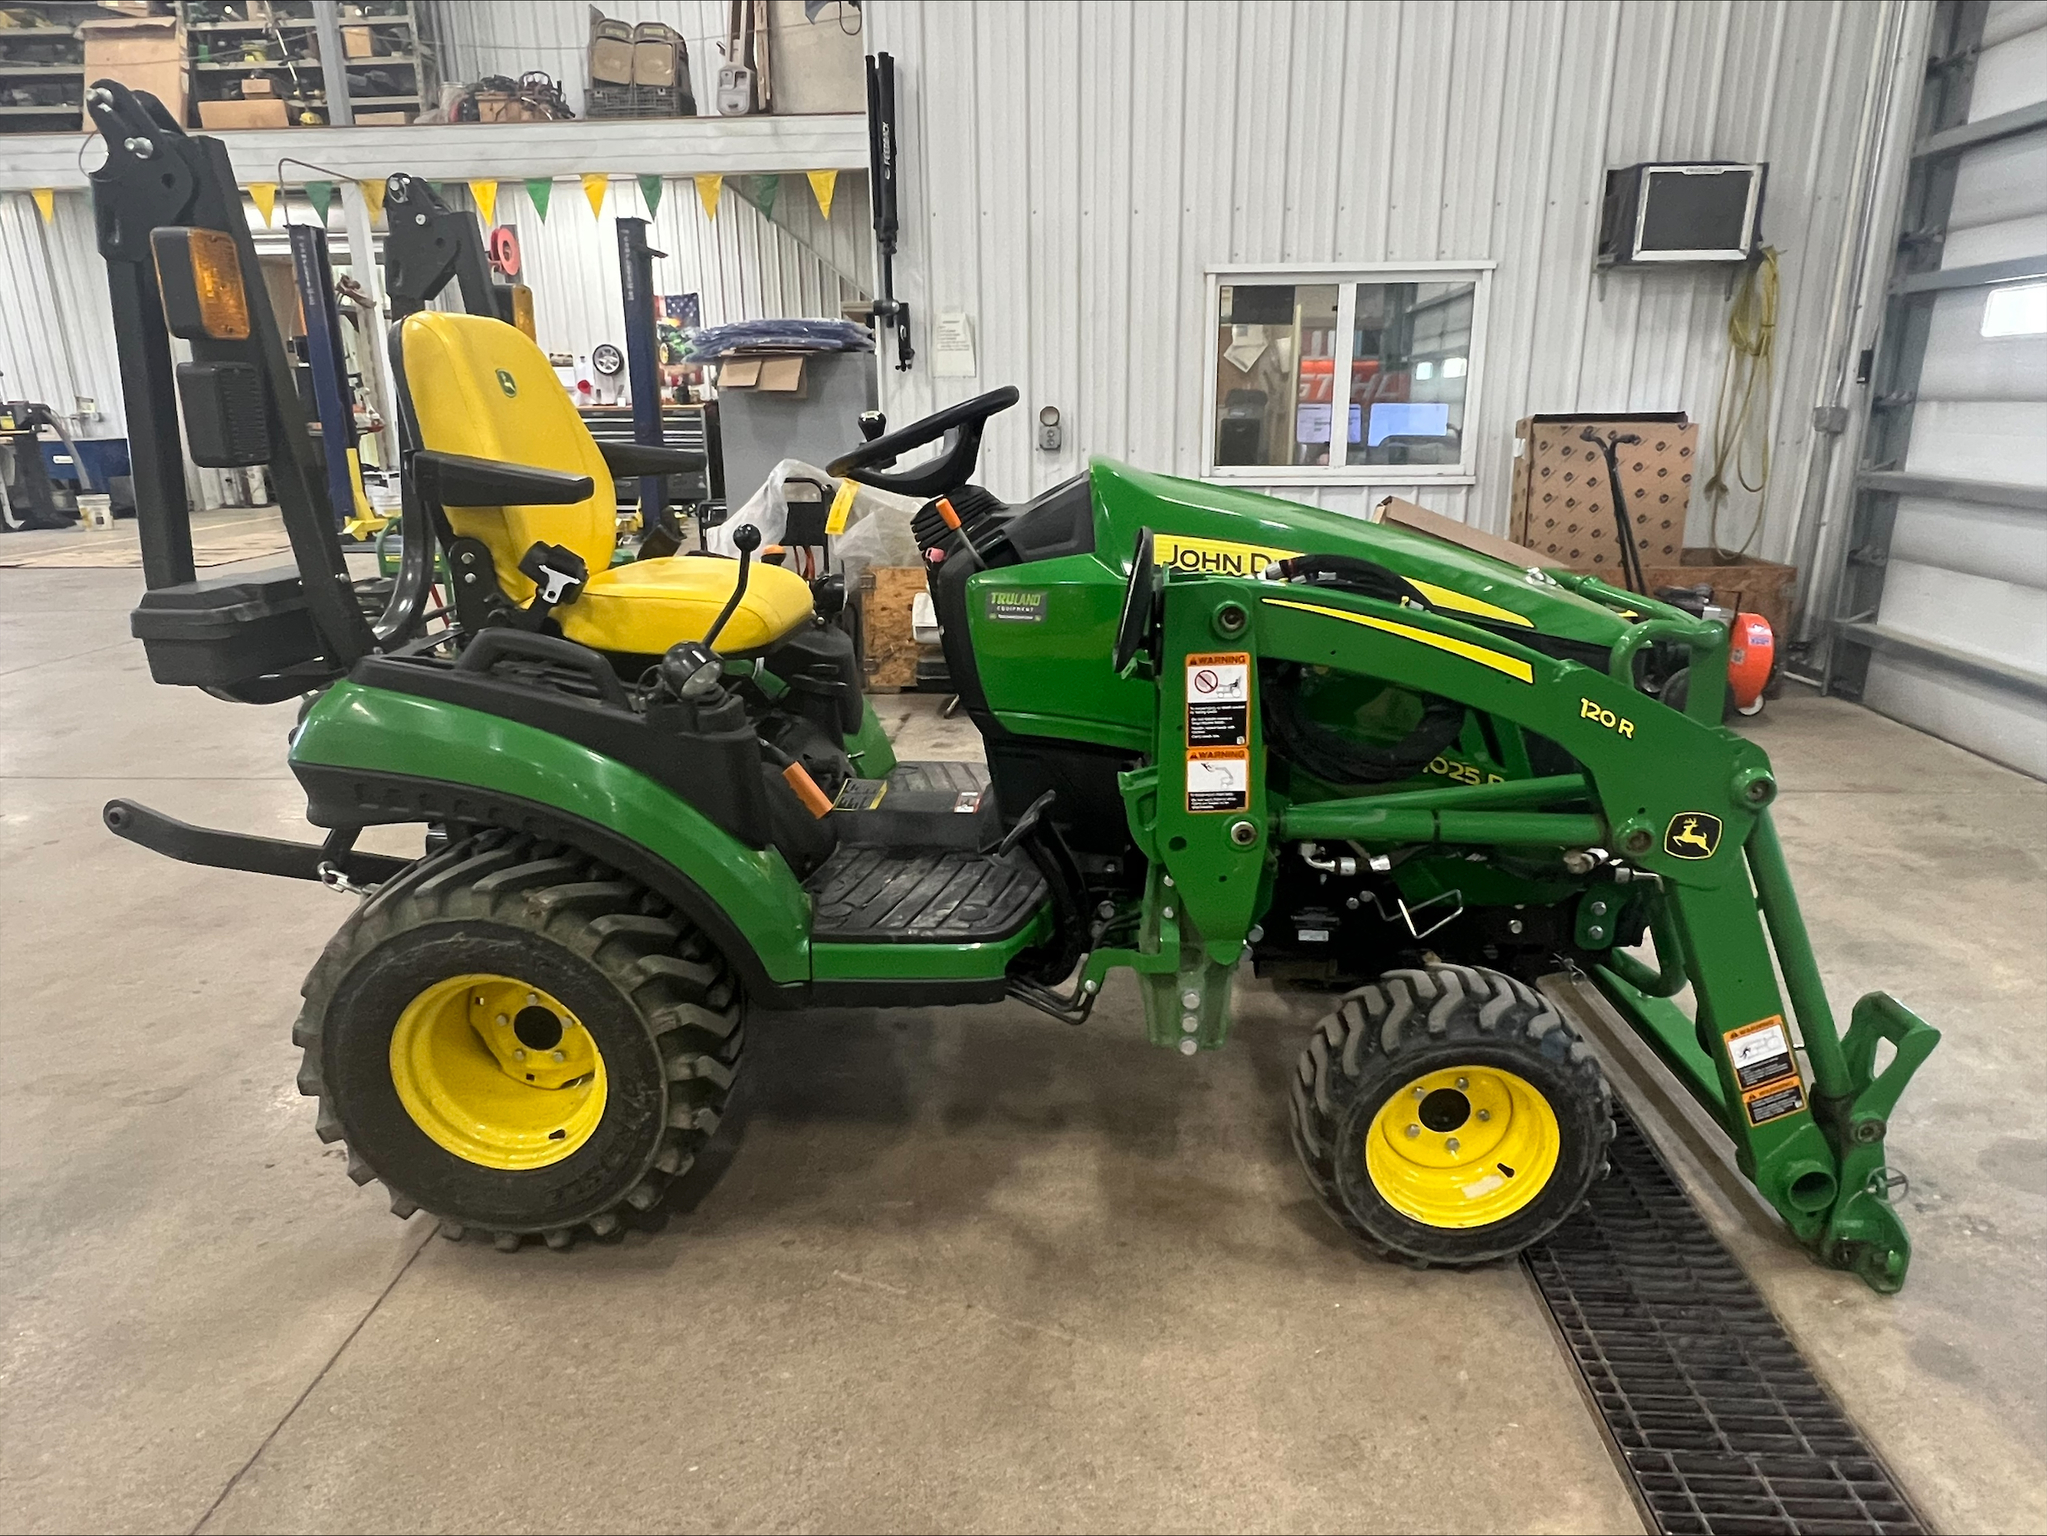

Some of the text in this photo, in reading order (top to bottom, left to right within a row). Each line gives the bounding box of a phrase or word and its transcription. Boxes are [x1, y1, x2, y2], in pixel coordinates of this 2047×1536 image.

[1168, 544, 1242, 573] JOHN
[991, 592, 1041, 607] TRULAND
[1199, 655, 1246, 665] WARNING
[1579, 697, 1635, 740] 120 R
[1198, 750, 1245, 759] WARNING
[1422, 756, 1481, 786] 025
